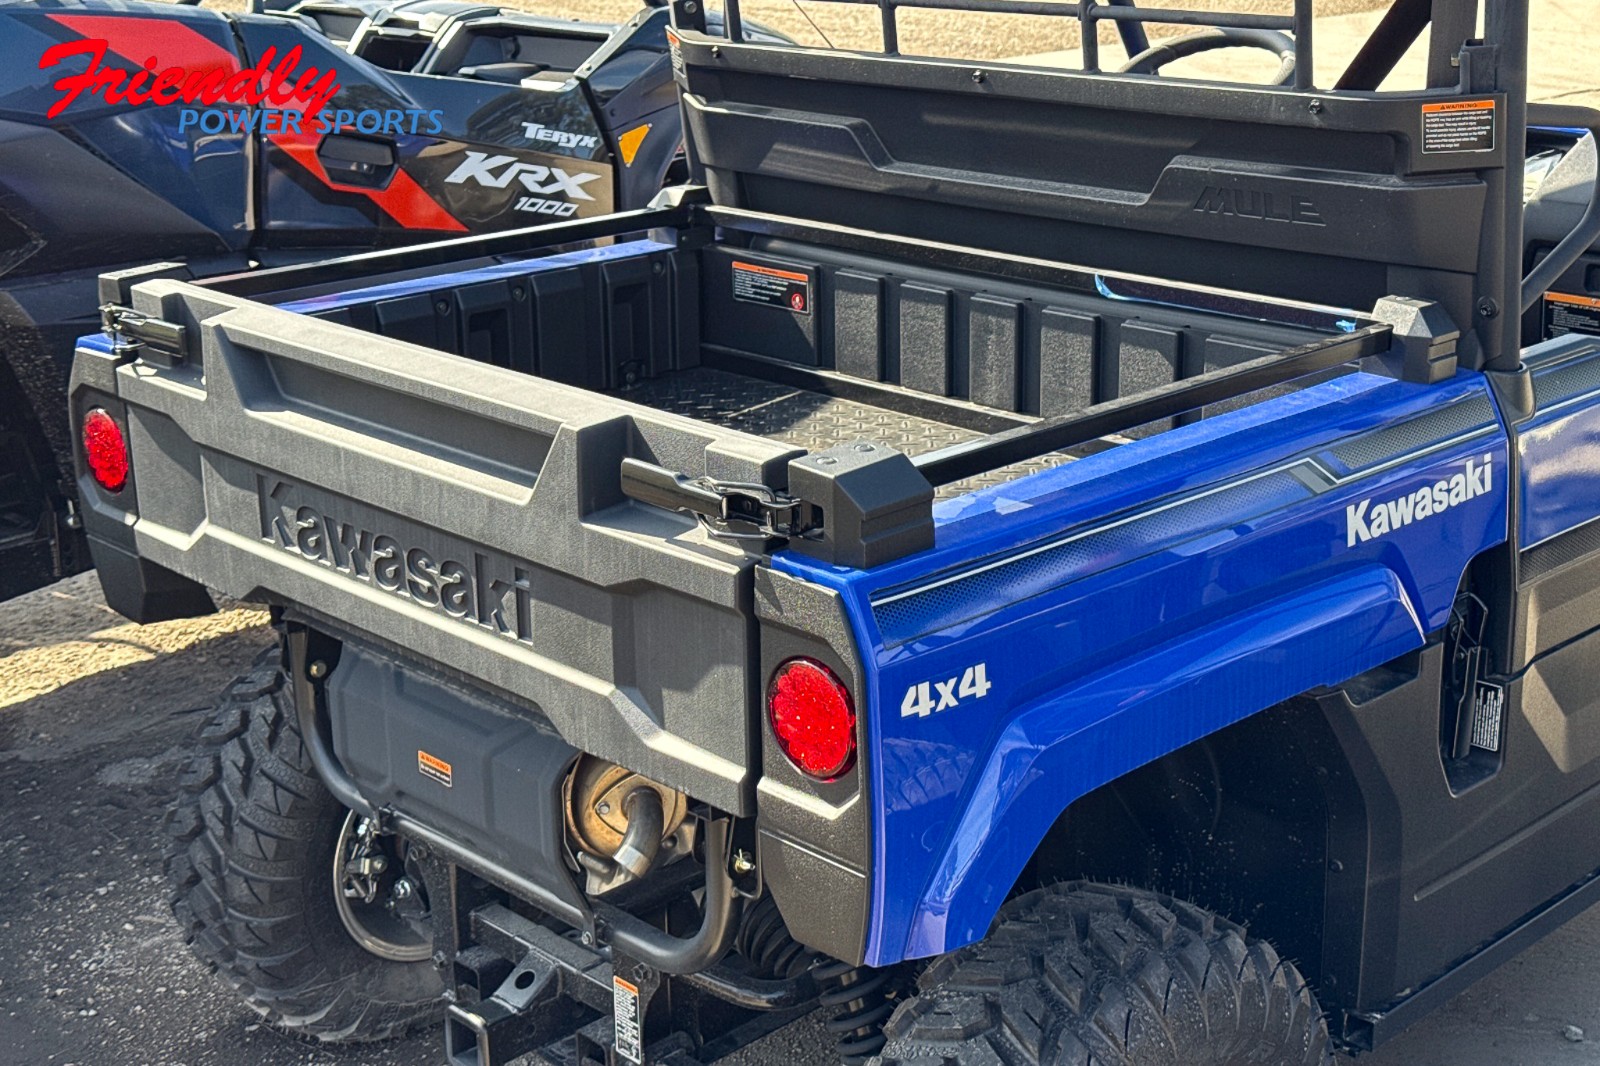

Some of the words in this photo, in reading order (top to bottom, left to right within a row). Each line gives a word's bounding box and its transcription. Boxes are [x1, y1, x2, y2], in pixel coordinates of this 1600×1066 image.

[443, 150, 602, 201] KRX
[513, 196, 579, 217] 1000
[1193, 185, 1327, 227] MULE
[1346, 451, 1492, 548] Kawasaki
[255, 473, 534, 646] Kawasaki
[900, 662, 992, 718] 4x4
